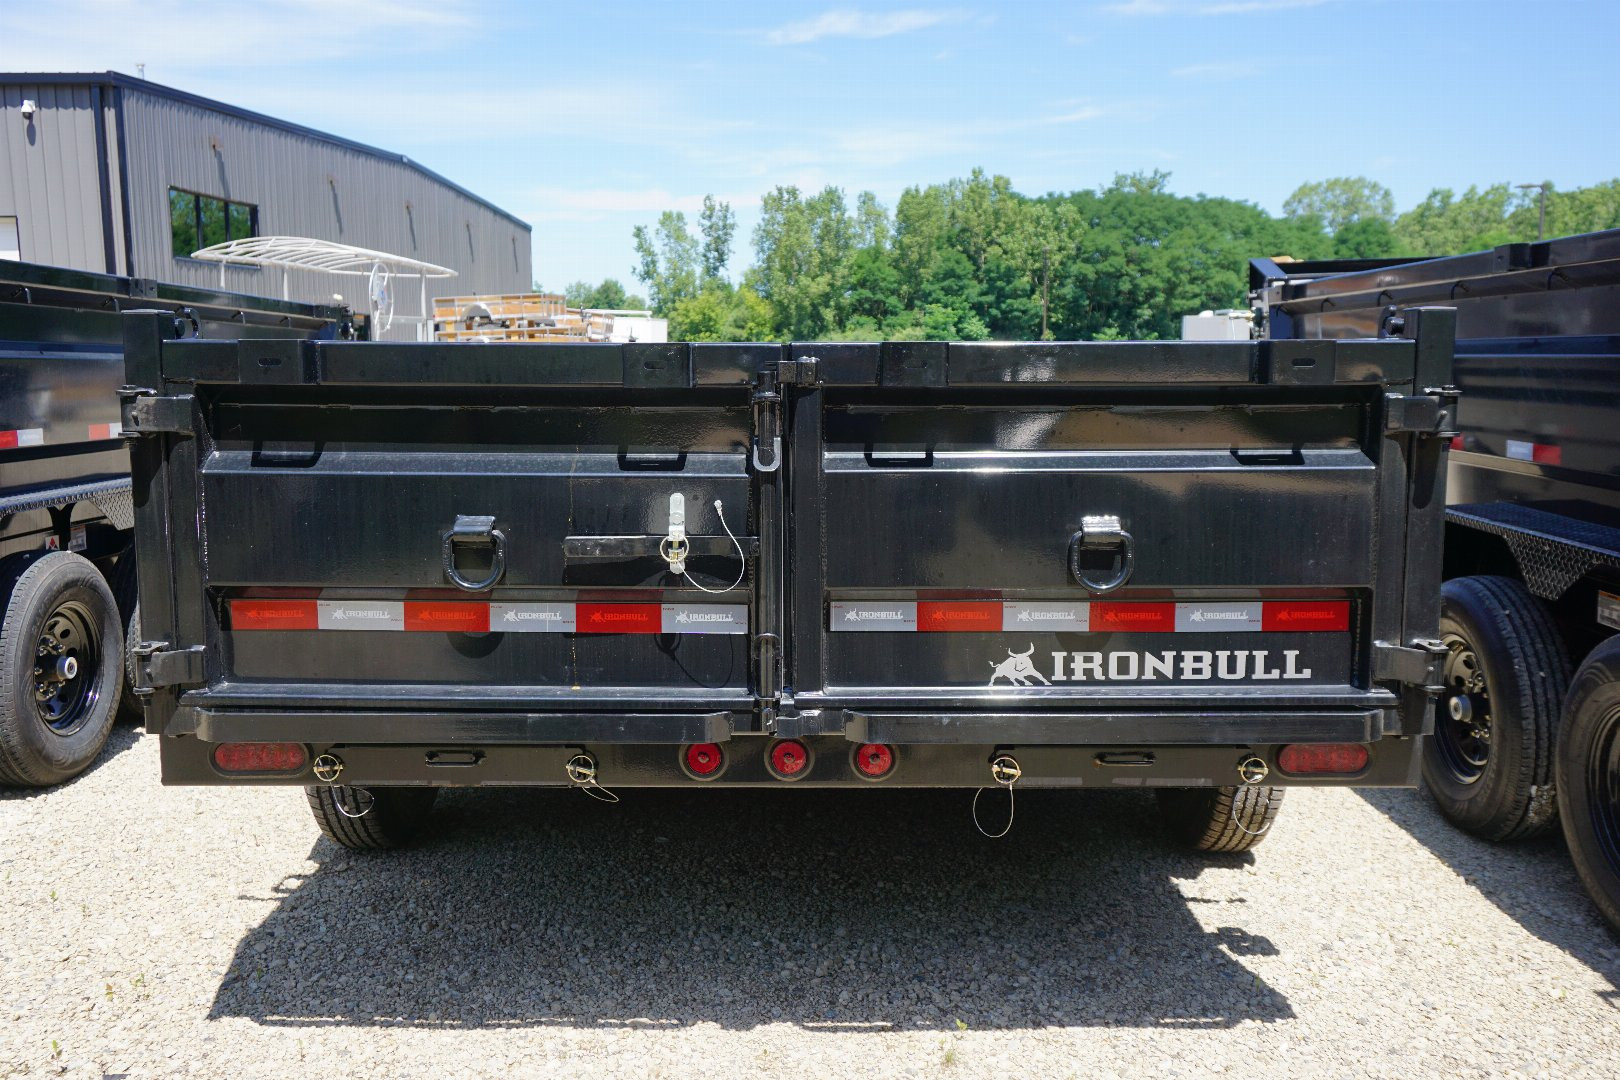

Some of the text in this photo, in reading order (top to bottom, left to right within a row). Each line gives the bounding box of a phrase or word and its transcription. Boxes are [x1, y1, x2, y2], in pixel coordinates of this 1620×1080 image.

[345, 610, 391, 618] IRONBULL
[517, 612, 562, 620] IRONBULL
[690, 613, 734, 622] IRONBULL
[859, 611, 903, 619] IRONBULL
[1031, 611, 1076, 619] IRONBULL
[1118, 612, 1162, 620] IRONBULL
[1204, 611, 1249, 620] IRONBULL
[1051, 650, 1312, 681] IRONBULL
